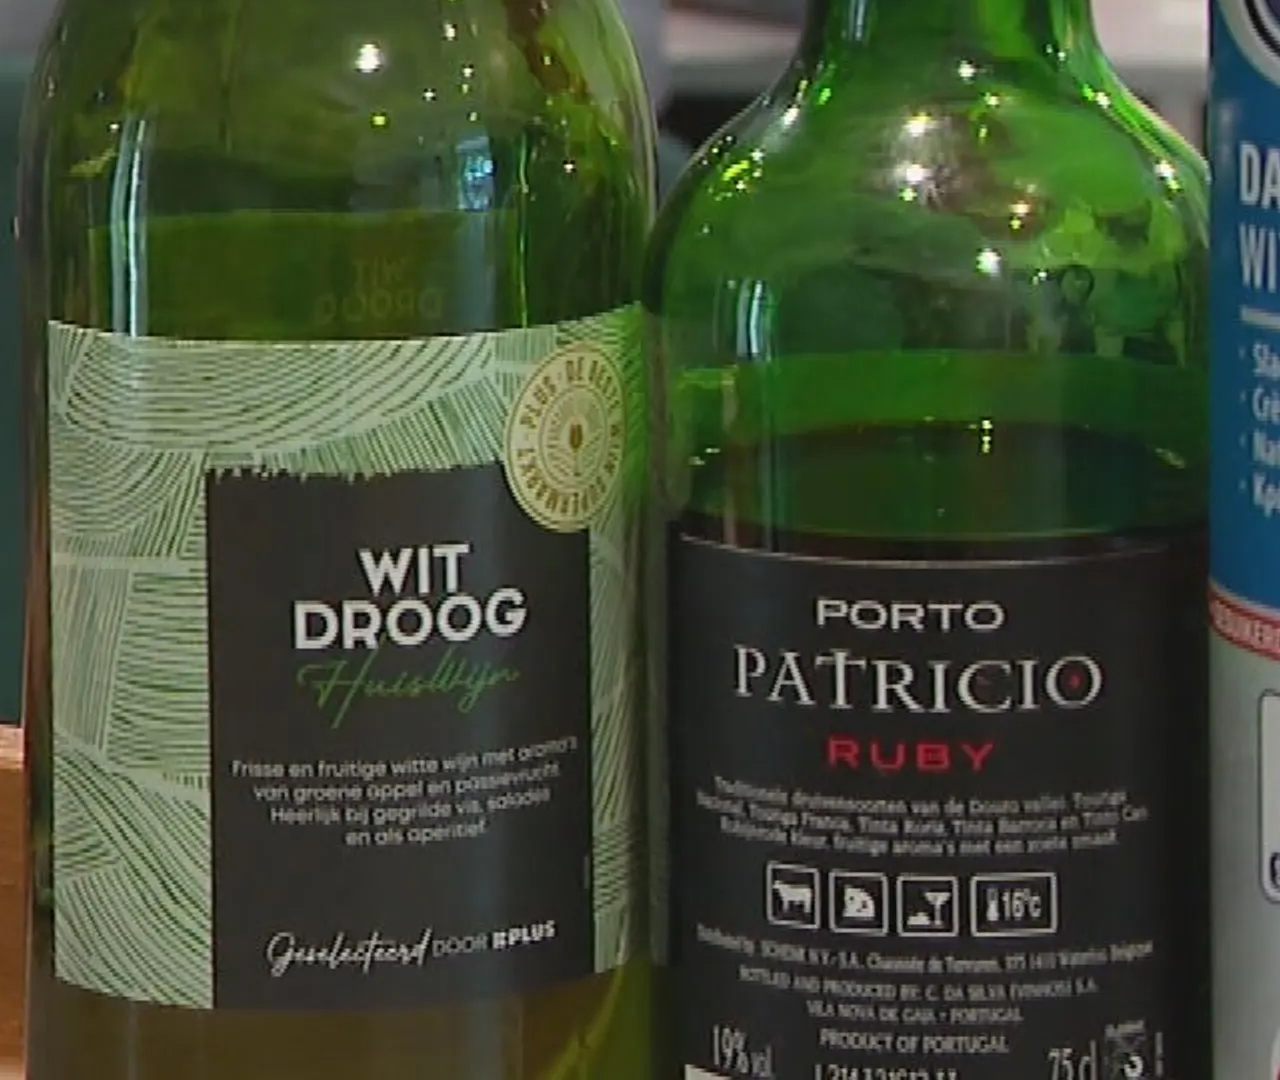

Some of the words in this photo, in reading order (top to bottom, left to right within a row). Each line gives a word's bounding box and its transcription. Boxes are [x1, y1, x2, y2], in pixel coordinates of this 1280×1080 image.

[358, 543, 470, 597] WIT
[294, 587, 527, 650] DROOG
[816, 599, 1005, 632] PORTO
[732, 642, 1104, 714] PATRICIO
[232, 760, 284, 778] Frisse
[289, 764, 314, 778] en
[319, 760, 387, 782] fruitige
[391, 756, 439, 776] witte
[442, 753, 479, 773] wijn
[482, 747, 515, 766] met
[826, 737, 995, 772] RUBY
[253, 786, 289, 802] van
[293, 786, 363, 806] groene
[367, 779, 424, 803] appel
[427, 780, 452, 794] en
[271, 806, 341, 826] Heerlijk
[345, 805, 369, 826] bij
[373, 800, 452, 826] gegrilde
[345, 831, 370, 846] en
[374, 827, 404, 846] als
[432, 933, 488, 958] DOOR
[508, 920, 556, 946] PLUS
[950, 1007, 1023, 1025] PORTUGAL
[820, 1027, 893, 1050] PRODUCT
[896, 1035, 919, 1053] OF
[922, 1035, 1010, 1054] PORTUGAL
[1048, 1047, 1074, 1080] 75
